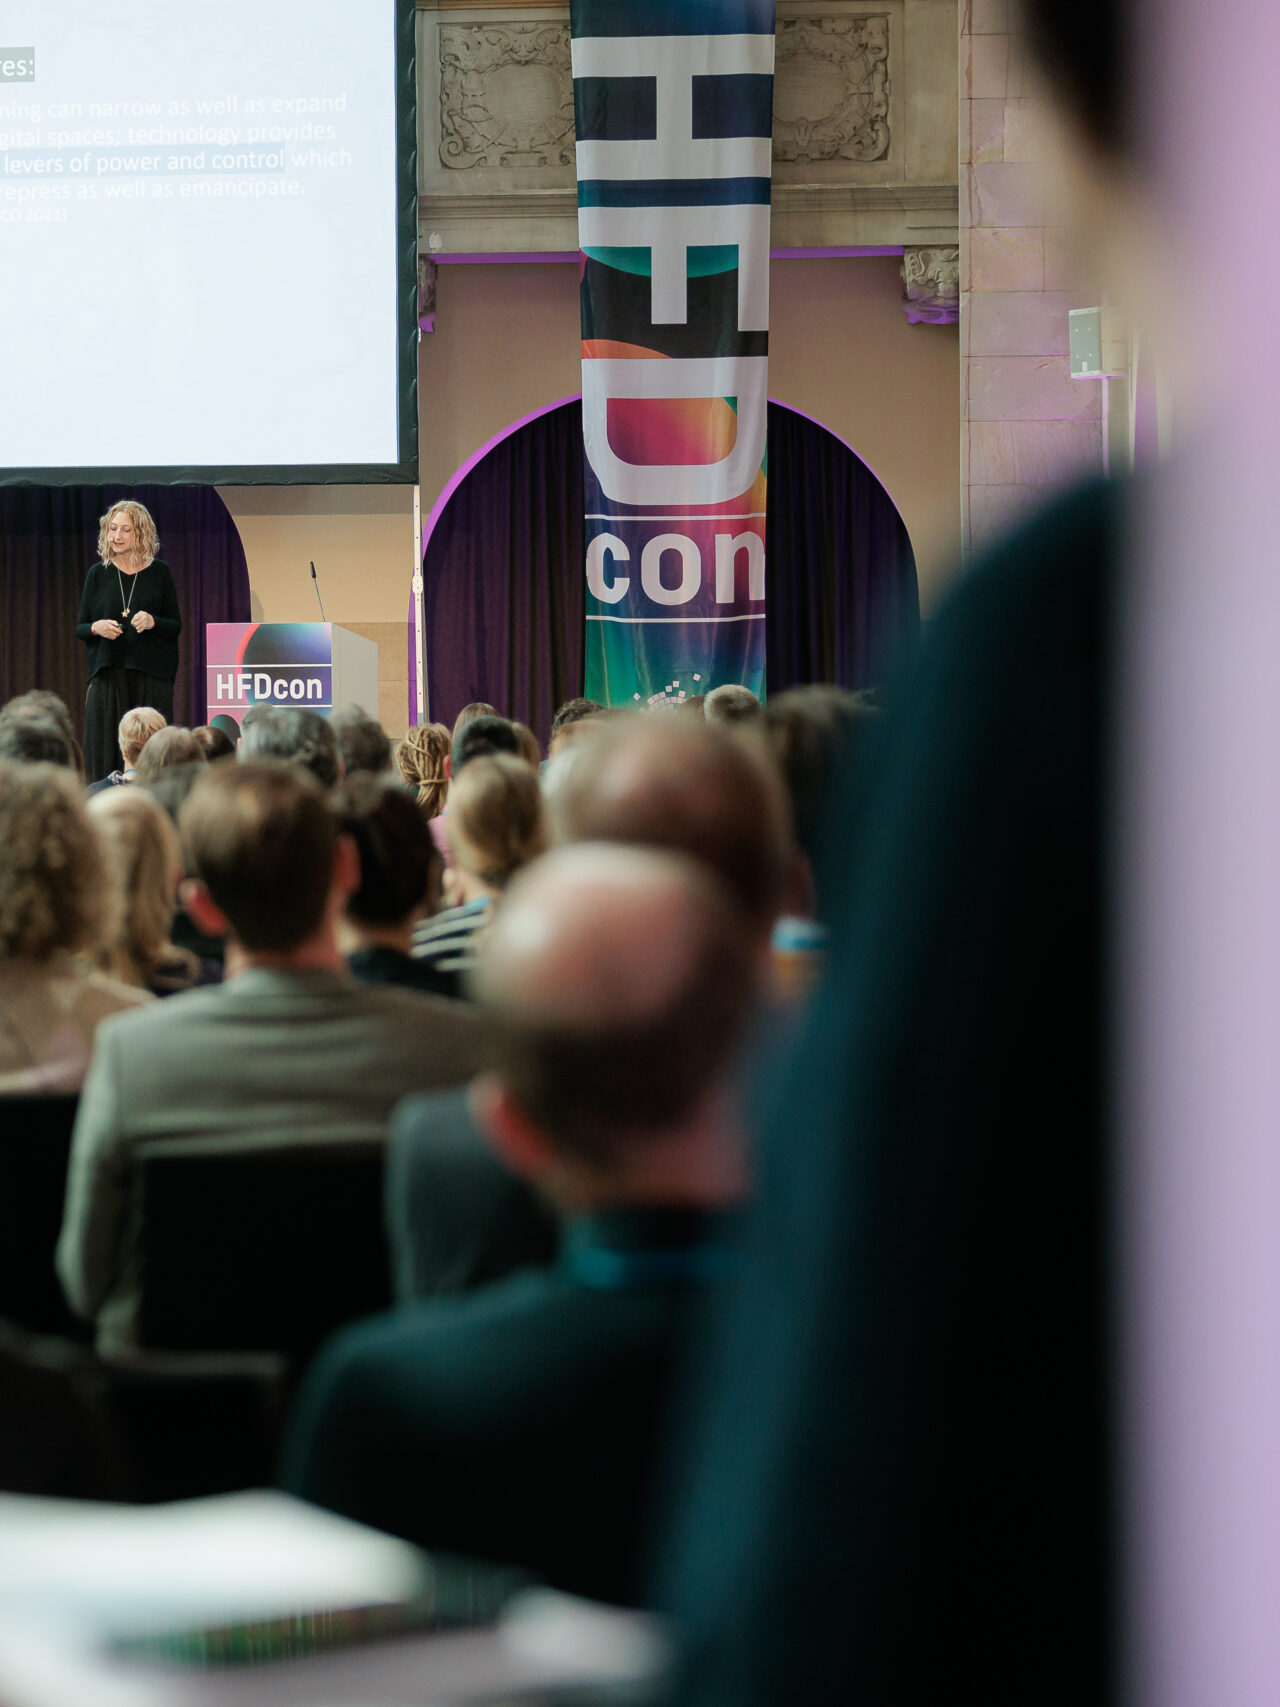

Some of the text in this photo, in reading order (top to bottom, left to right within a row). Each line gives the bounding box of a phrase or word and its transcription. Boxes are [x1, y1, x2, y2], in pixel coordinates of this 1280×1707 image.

[48, 103, 82, 118] can
[89, 102, 161, 117] narrow
[169, 102, 190, 115] as
[196, 97, 237, 115] well
[244, 100, 266, 114] as
[272, 94, 347, 117] expand
[128, 126, 241, 146] technology
[247, 124, 336, 144] provides
[4, 155, 63, 173] levers
[70, 153, 91, 172] of
[97, 156, 161, 176] power
[167, 152, 205, 169] and
[211, 149, 285, 169] control
[290, 149, 352, 167] which
[77, 184, 98, 198] as
[104, 180, 146, 198] well
[151, 183, 173, 197] as
[180, 178, 304, 198] emancipate.
[570, 34, 775, 505] HFD
[585, 530, 765, 606] con
[216, 673, 322, 700] HFDcon
